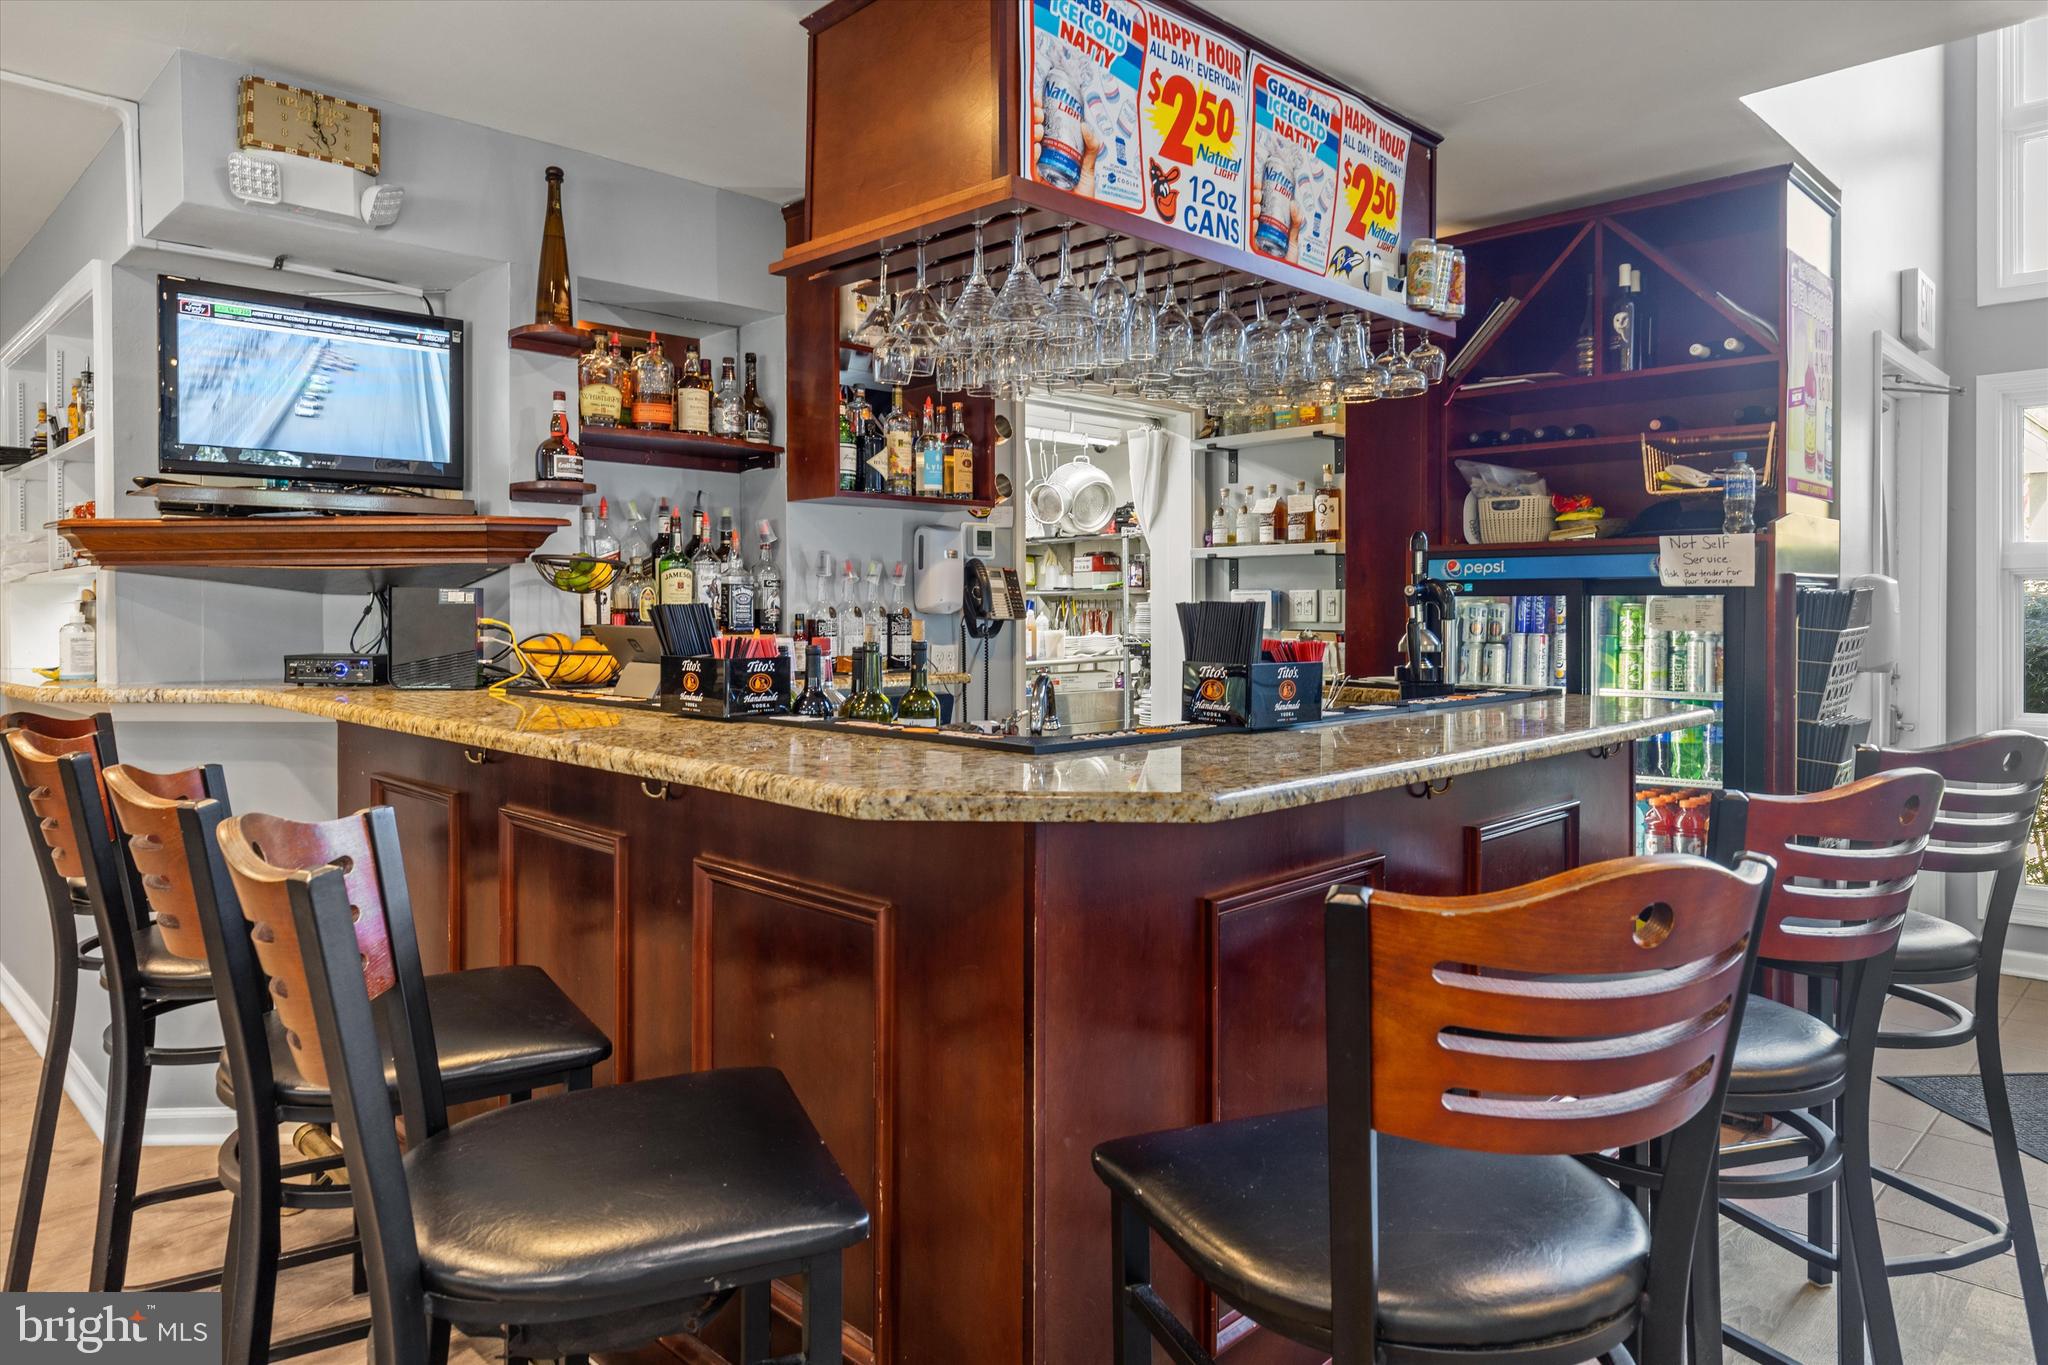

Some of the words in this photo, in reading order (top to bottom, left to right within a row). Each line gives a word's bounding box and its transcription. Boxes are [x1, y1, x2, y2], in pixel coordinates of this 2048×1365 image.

[1053, 0, 1078, 24] ICE
[1084, 15, 1125, 54] COLD
[1060, 20, 1116, 69] NATTY
[1149, 11, 1201, 57] HAPPY
[1205, 38, 1242, 81] HOUR
[1149, 40, 1168, 61] ALL
[1171, 49, 1194, 73] DAY!
[1197, 62, 1243, 98] EVERYDAY!
[1267, 77, 1307, 112] GRAB
[1268, 95, 1288, 119] ICE
[1291, 111, 1326, 141] COLD
[1275, 117, 1319, 154] NATTY
[1343, 133, 1356, 150] ALL
[1358, 140, 1373, 159] DAY!
[1344, 105, 1377, 144] HAPPY
[1379, 127, 1406, 162] HOUR
[1196, 143, 1242, 173] Natural
[1213, 167, 1238, 182] LIGHT
[1184, 205, 1240, 244] CANS
[1367, 220, 1400, 246] Natural
[1376, 241, 1396, 254] LIGHT
[1669, 535, 1697, 549] Not
[665, 571, 692, 581] JAMESON
[1464, 560, 1505, 576] pepsi
[743, 691, 779, 703] Handmade
[1193, 699, 1231, 712] Handmade
[1274, 699, 1301, 712] Handmade
